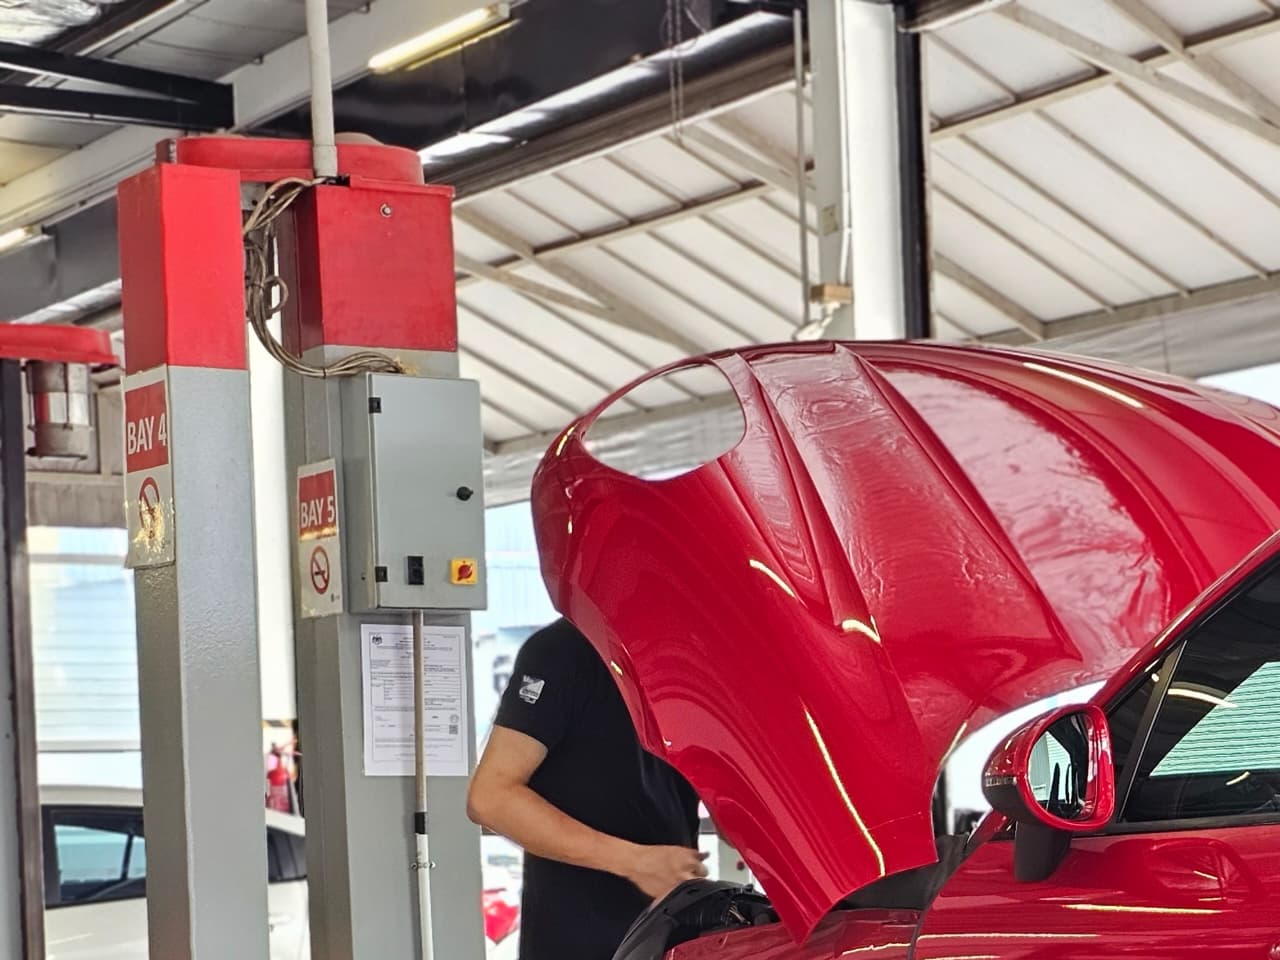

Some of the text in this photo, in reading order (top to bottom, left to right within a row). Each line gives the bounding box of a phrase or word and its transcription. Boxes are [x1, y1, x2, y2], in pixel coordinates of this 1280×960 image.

[127, 412, 167, 455] BAY 4
[301, 496, 336, 529] BAY 5
